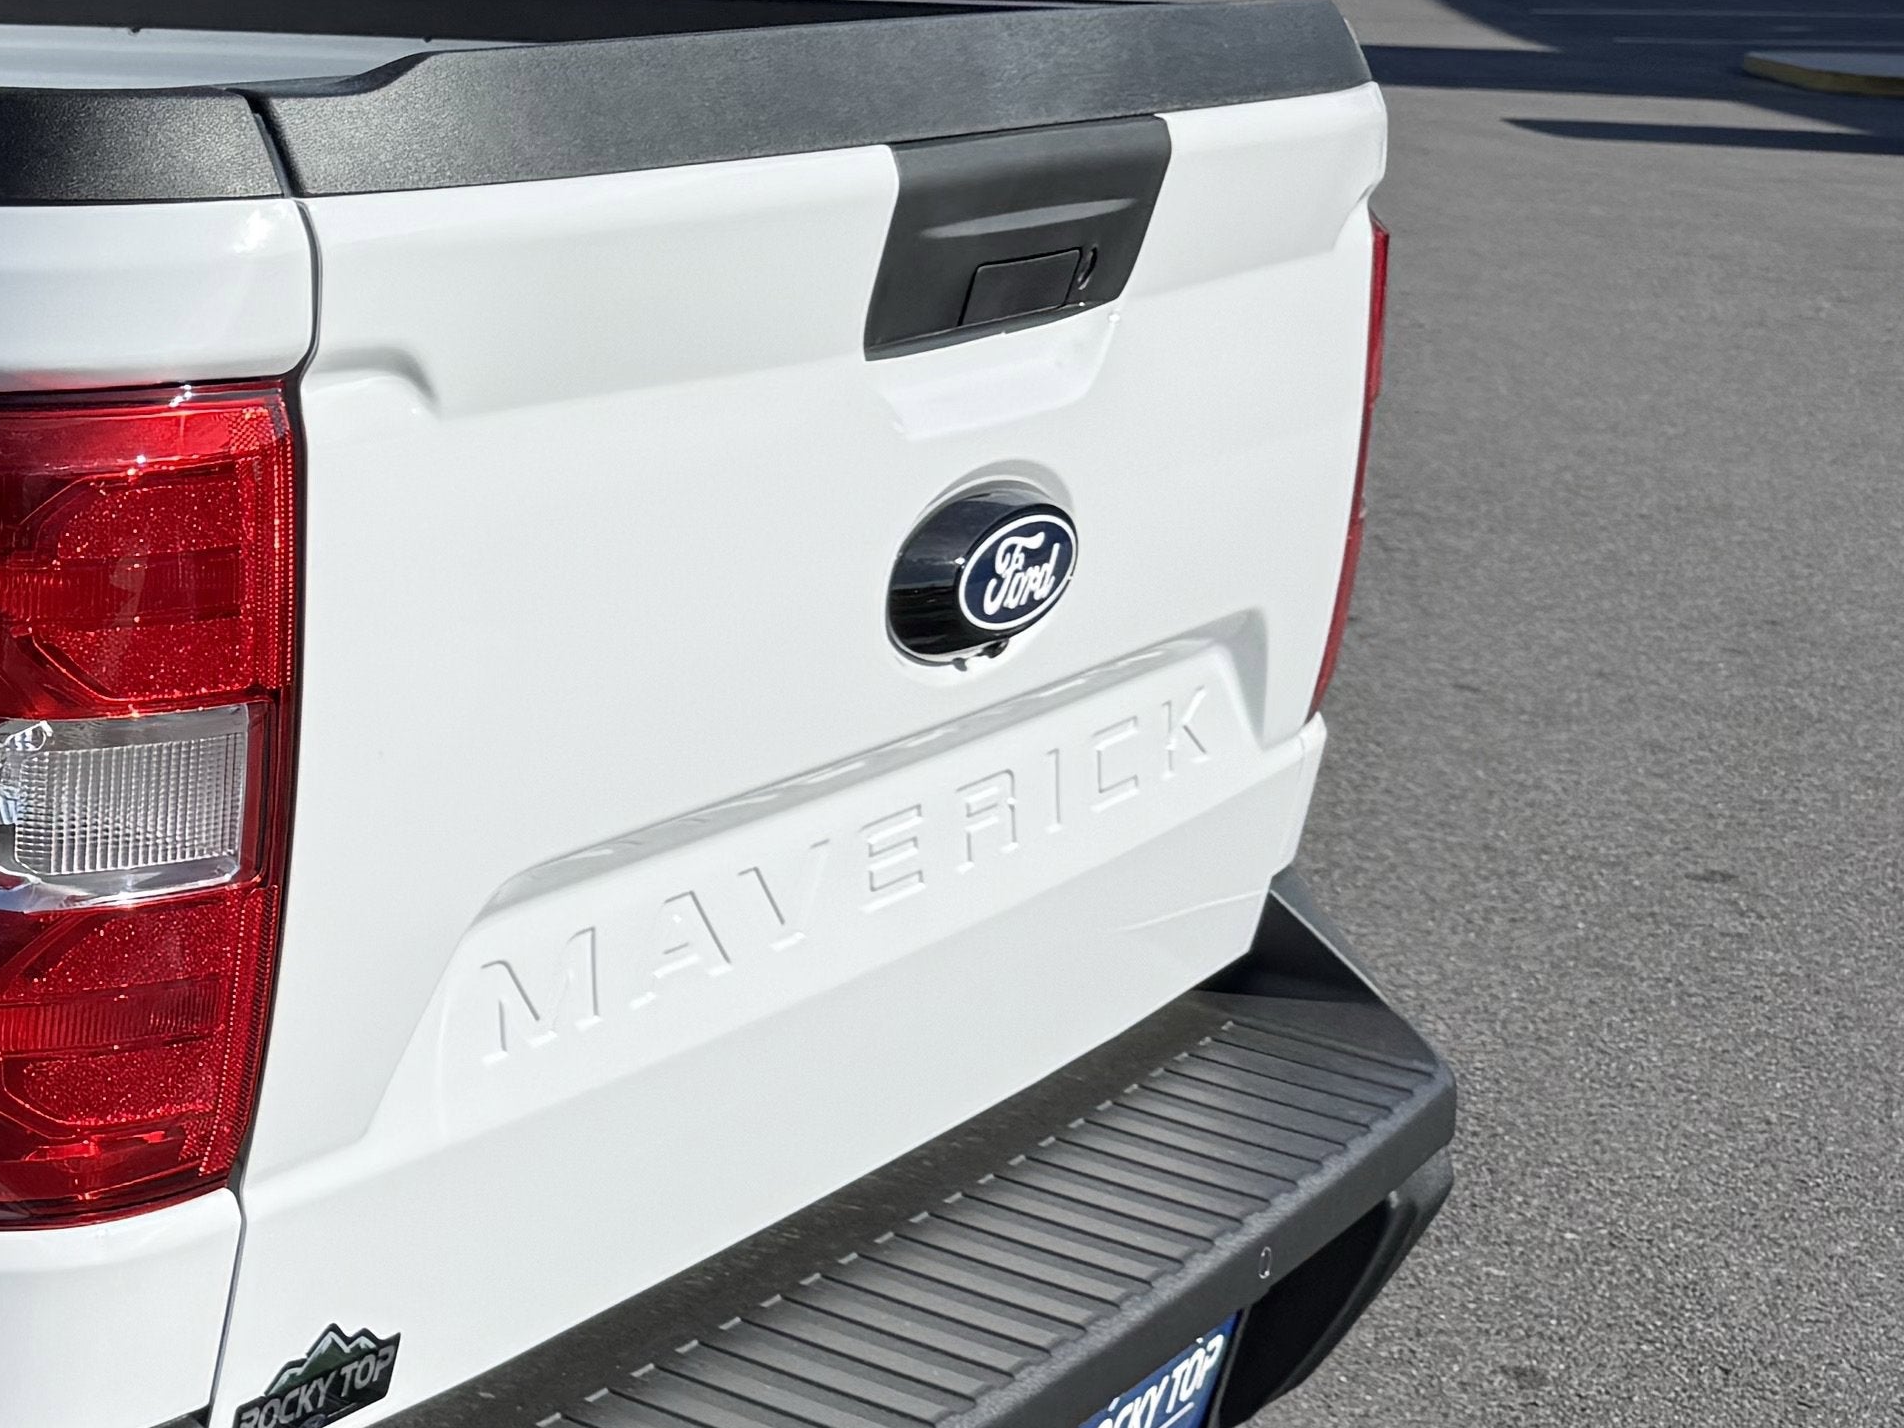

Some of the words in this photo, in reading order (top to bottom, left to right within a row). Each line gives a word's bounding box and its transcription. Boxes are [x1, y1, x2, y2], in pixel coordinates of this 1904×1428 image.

[983, 531, 1061, 616] Ford
[479, 685, 1209, 1064] MAVERICK
[340, 1345, 395, 1398] TOP
[1164, 1334, 1224, 1414] TOP
